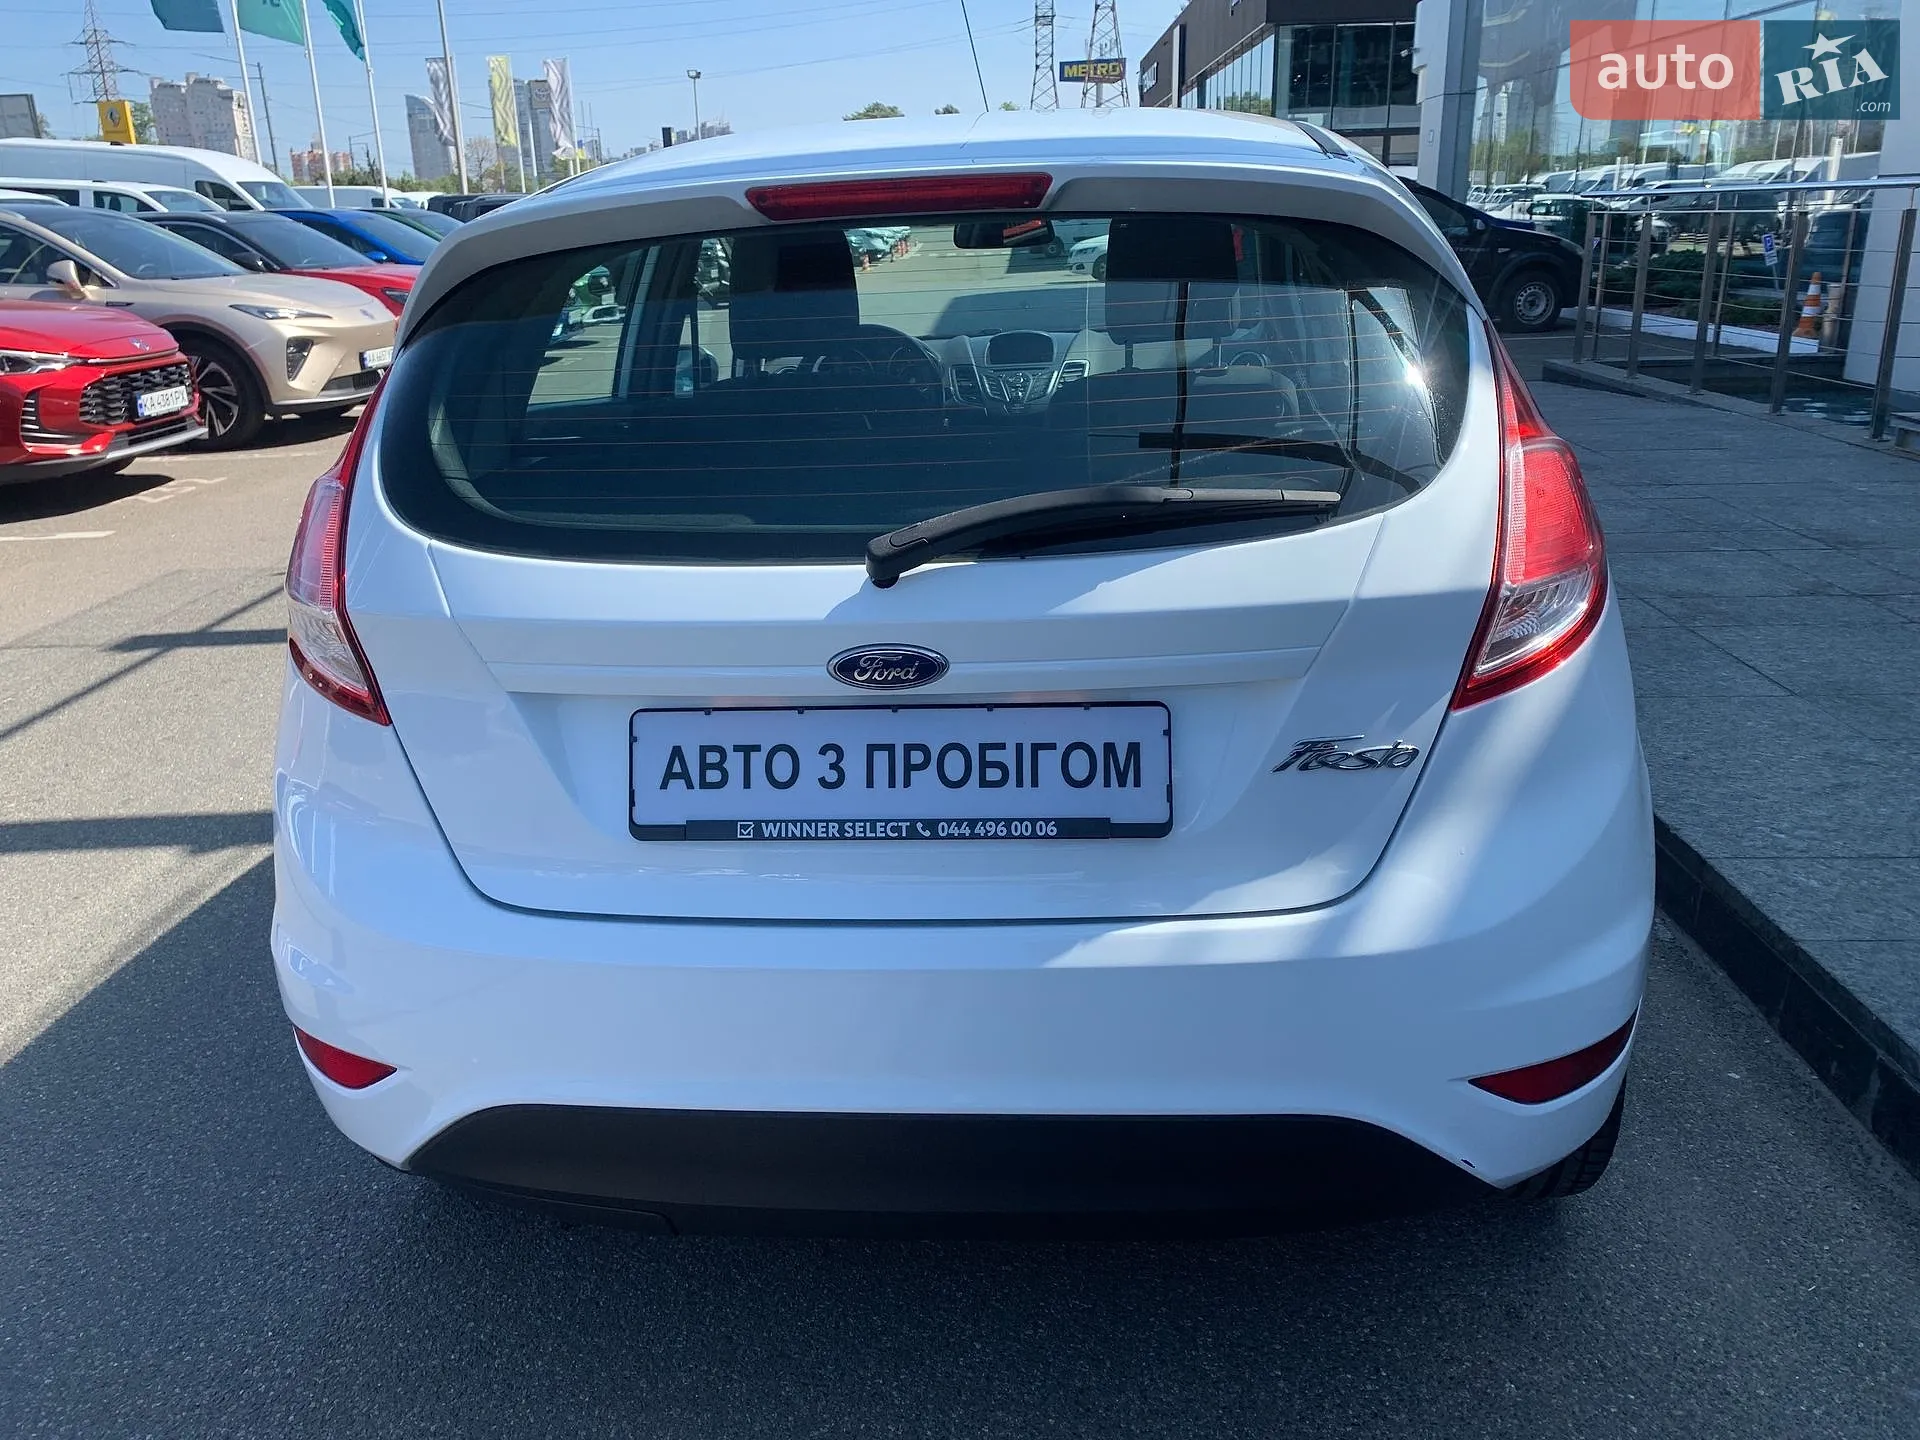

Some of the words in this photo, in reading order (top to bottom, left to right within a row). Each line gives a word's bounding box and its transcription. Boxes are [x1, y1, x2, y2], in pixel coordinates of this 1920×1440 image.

[854, 655, 919, 681] Ford
[659, 743, 800, 790] АВТО
[865, 741, 1142, 789] ПРОБІГОМ
[1271, 734, 1420, 773] Fiesta
[761, 822, 841, 838] WINNER
[844, 821, 910, 838] SELECT
[937, 821, 971, 837] 044
[974, 821, 1007, 837] 496
[1011, 820, 1032, 837] 00
[1035, 820, 1058, 836] 06
